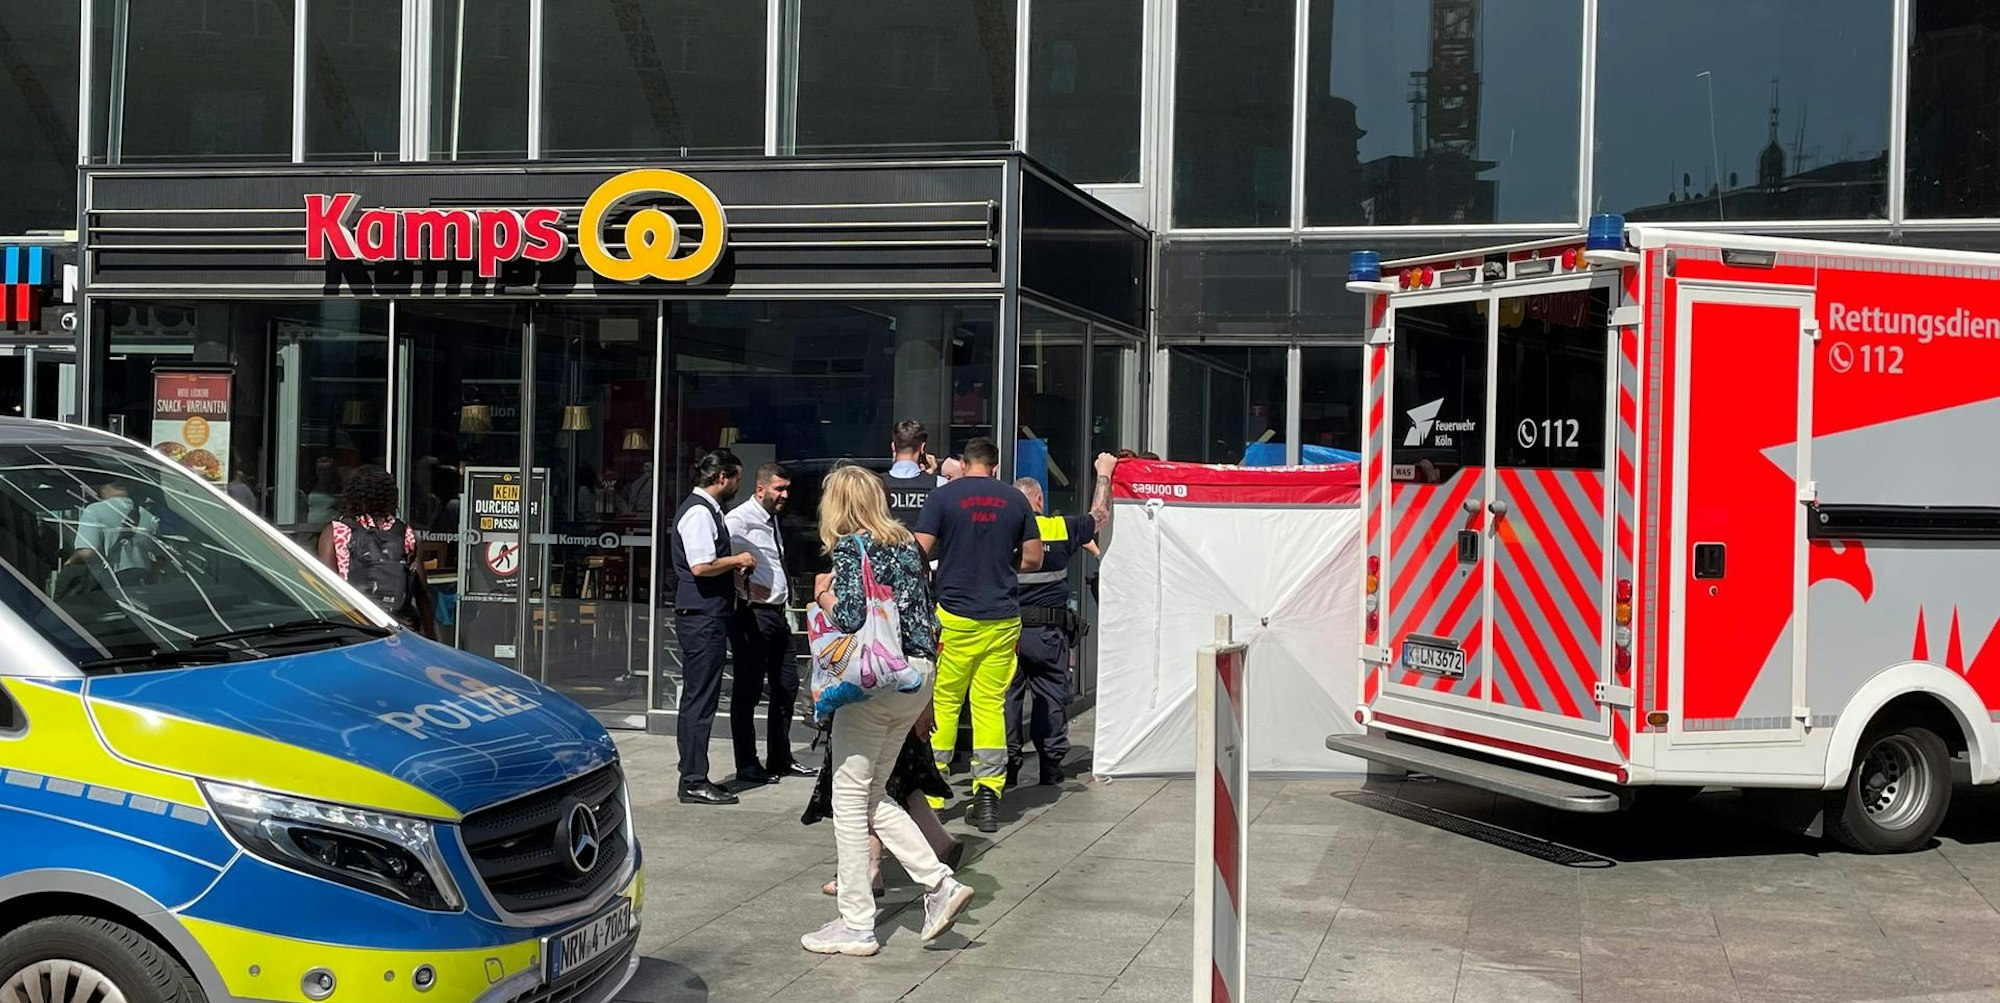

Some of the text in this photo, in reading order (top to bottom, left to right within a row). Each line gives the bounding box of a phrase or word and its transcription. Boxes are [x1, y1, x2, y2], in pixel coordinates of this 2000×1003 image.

[304, 193, 567, 277] Kamps
[1860, 345, 1904, 374] 112
[1435, 420, 1475, 432] Feuerwehr
[1541, 418, 1580, 448] 112
[1435, 433, 1452, 446] Köln
[495, 486, 518, 498] KEIN
[475, 500, 538, 515] DURCHGA!
[481, 518, 519, 529] NO PASSA
[422, 530, 460, 544] Kamps
[559, 533, 597, 547] Kamps
[376, 684, 542, 740] POLIZEI
[560, 929, 587, 972] NRW
